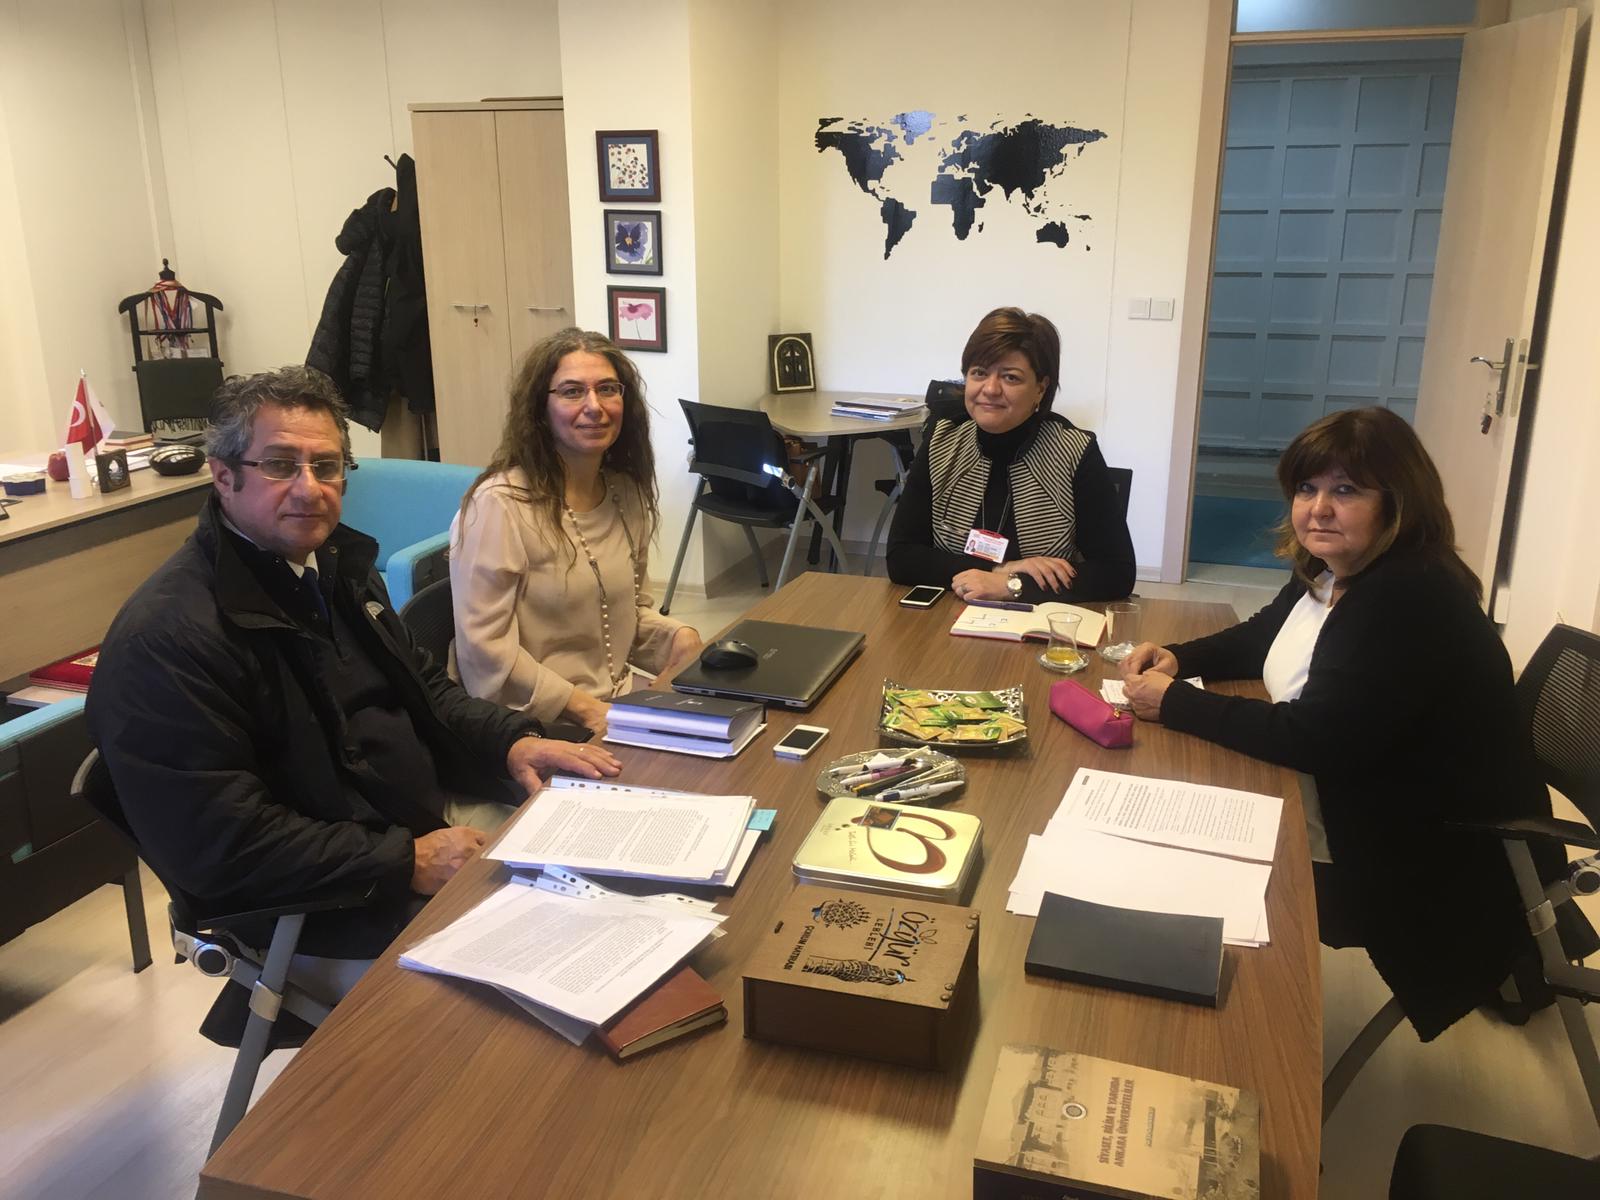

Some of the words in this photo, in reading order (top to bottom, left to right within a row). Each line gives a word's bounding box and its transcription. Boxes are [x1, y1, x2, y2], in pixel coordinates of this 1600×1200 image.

[798, 925, 815, 945] ÇORUM
[879, 911, 936, 967] Özgür
[783, 944, 804, 970] HATIRASI
[1106, 1106, 1117, 1114] VE
[1101, 1115, 1115, 1134] BİLİM
[1113, 1136, 1127, 1167] ANKARA
